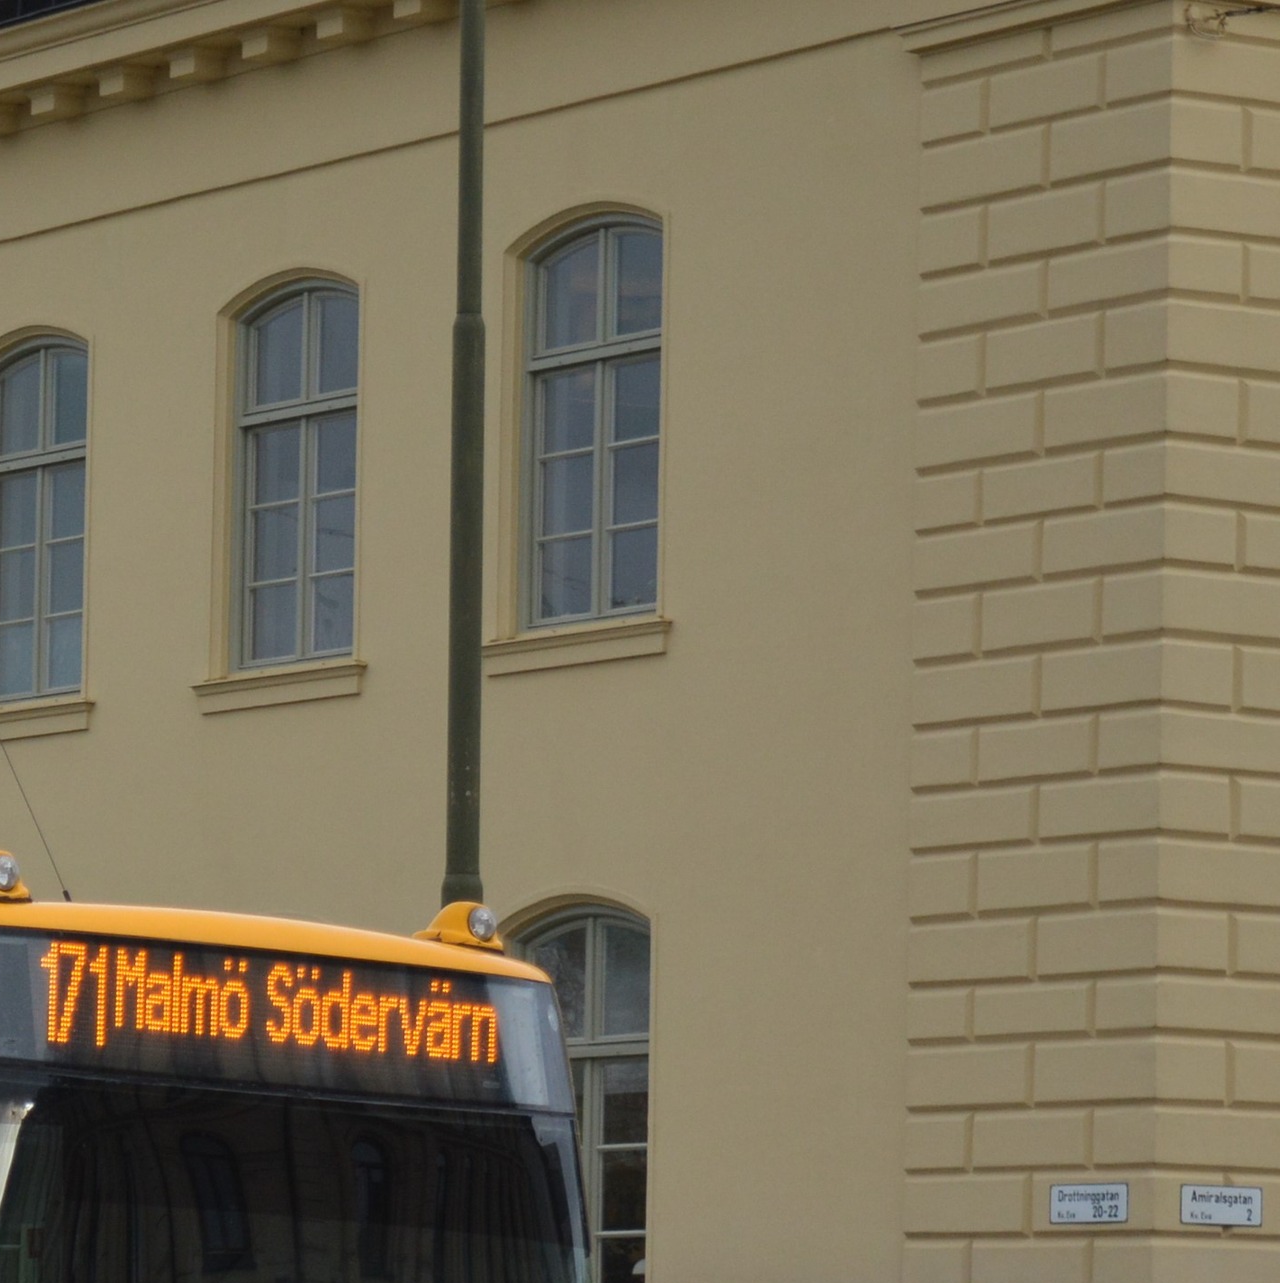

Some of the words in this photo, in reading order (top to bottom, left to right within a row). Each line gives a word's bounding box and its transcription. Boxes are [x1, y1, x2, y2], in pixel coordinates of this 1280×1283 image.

[40, 941, 107, 1047] 171
[116, 947, 249, 1039] Malmö
[267, 963, 497, 1063] Södervärn
[1058, 1190, 1119, 1205] Drottninggatan
[1191, 1190, 1253, 1207] Amiralsgatan
[1092, 1205, 1118, 1218] 20-22
[1246, 1209, 1253, 1221] 2
